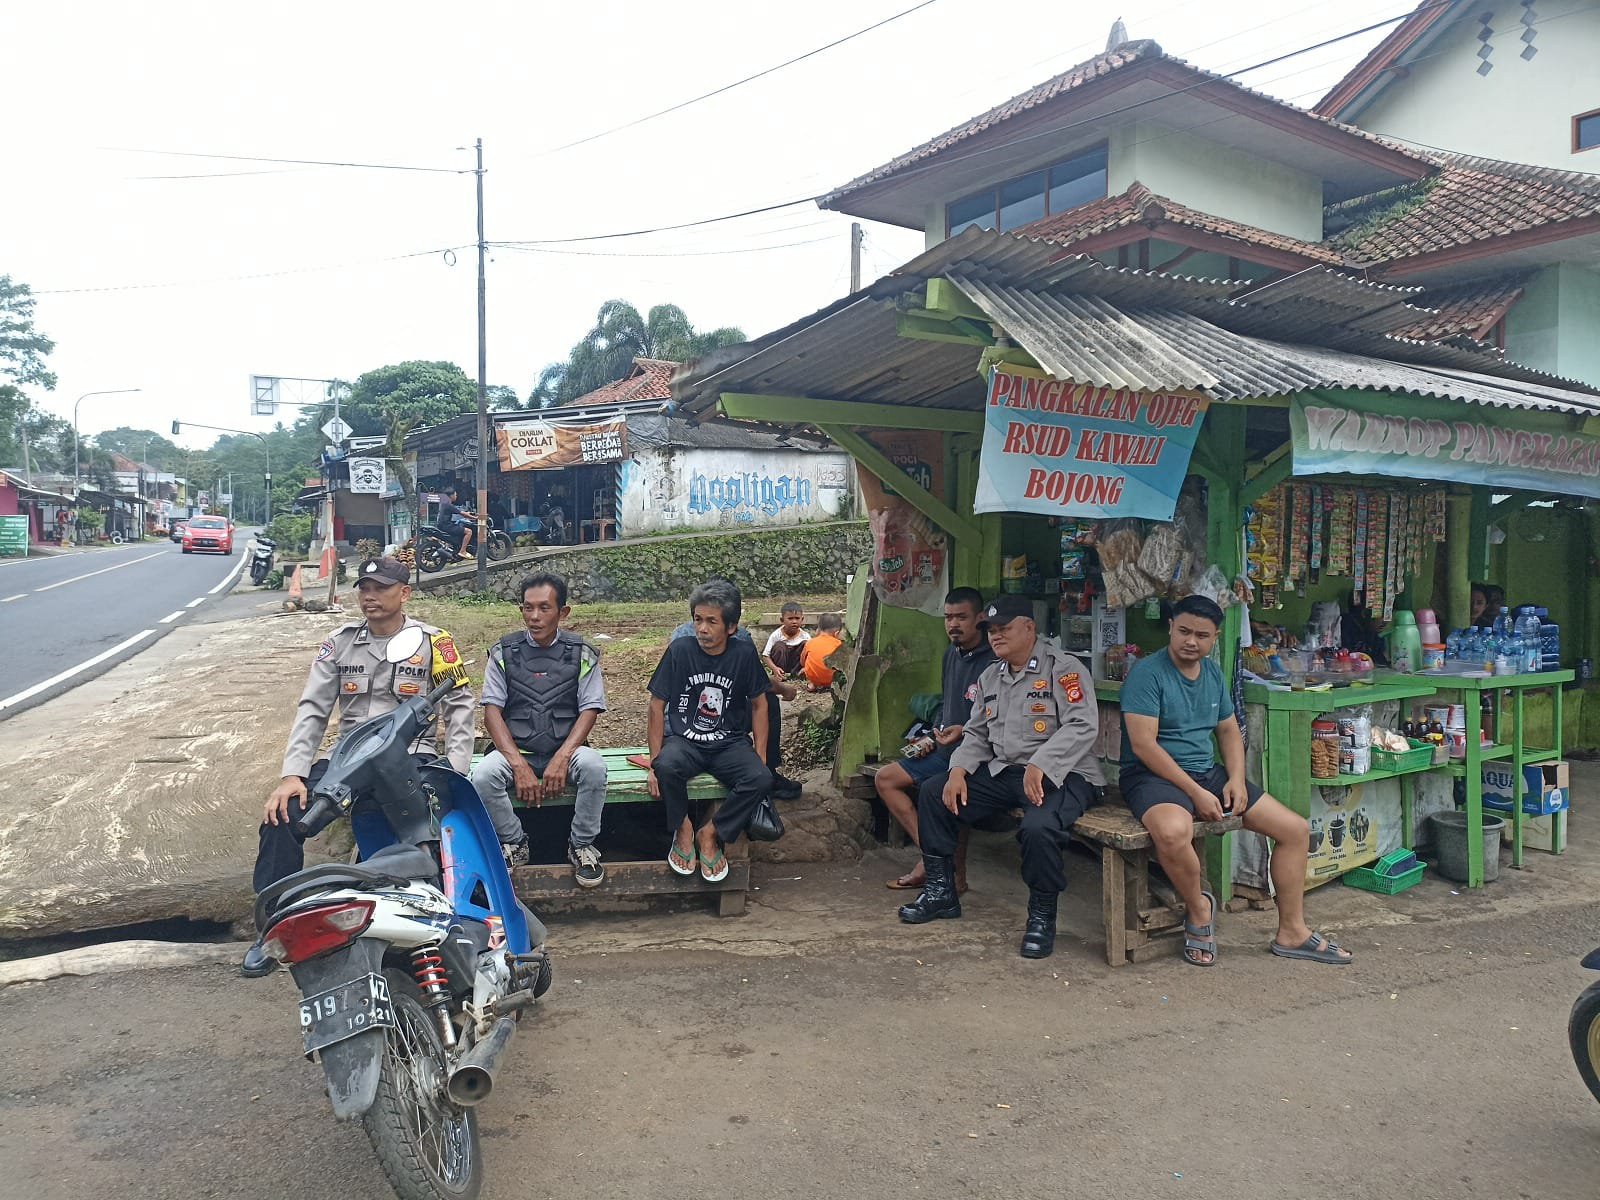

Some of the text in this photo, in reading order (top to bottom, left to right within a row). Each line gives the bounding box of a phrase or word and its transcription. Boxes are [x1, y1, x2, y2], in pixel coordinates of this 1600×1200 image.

[989, 373, 1201, 429] PANGKALAN OJEG
[511, 436, 554, 449] COKLAT
[1002, 421, 1167, 467] RSUD KAWALI
[1450, 422, 1600, 477] PANGKALA
[1024, 468, 1125, 506] BOJONG
[398, 667, 427, 677] POLRI
